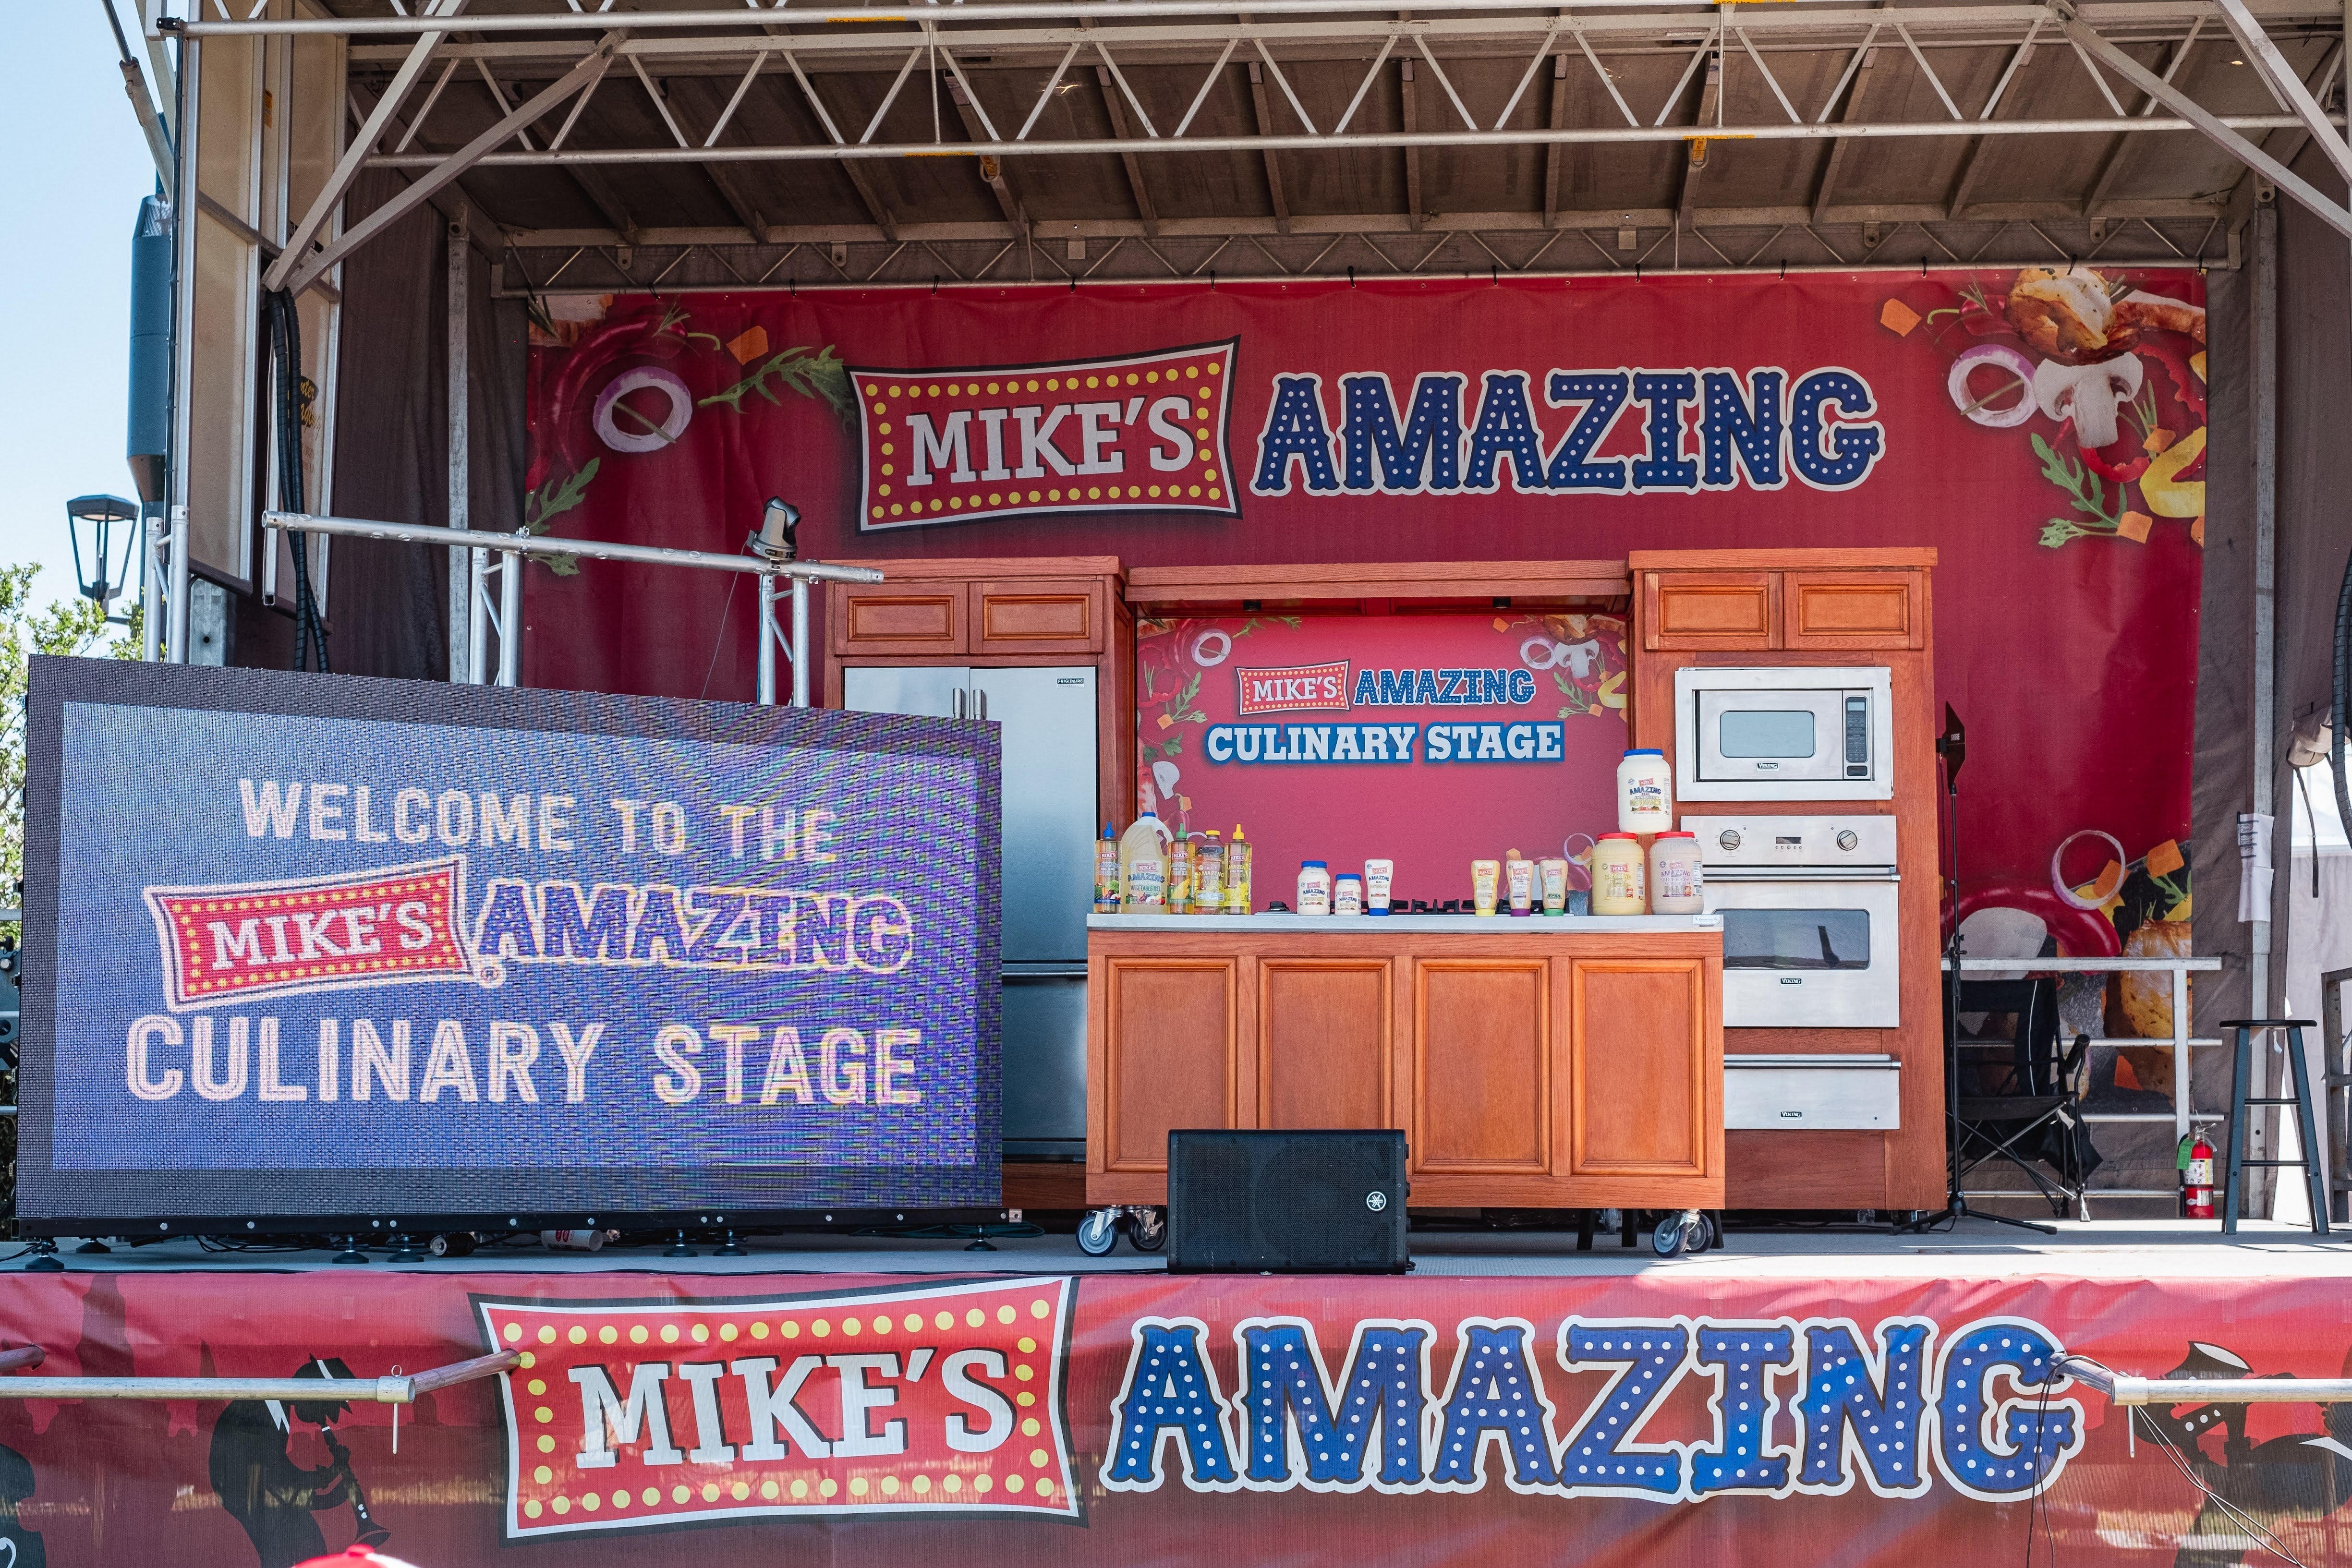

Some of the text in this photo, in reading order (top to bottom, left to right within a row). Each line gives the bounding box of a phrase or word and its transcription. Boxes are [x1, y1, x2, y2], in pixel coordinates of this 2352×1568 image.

[906, 367, 1885, 496] MIKE'S AMAZING
[1252, 668, 1535, 706] MIKE'S AMAZING
[1208, 724, 1561, 761] CULINARY STAGE
[239, 779, 838, 862] WELCOME TO THE
[1630, 786, 1661, 795] AMAZING
[1128, 873, 1165, 883] AMAZING
[207, 879, 913, 973] MIKE'S AMAZING
[126, 1012, 921, 1106] CULINARY STAGE
[568, 1315, 2085, 1501] MIKE'S AMAZING
